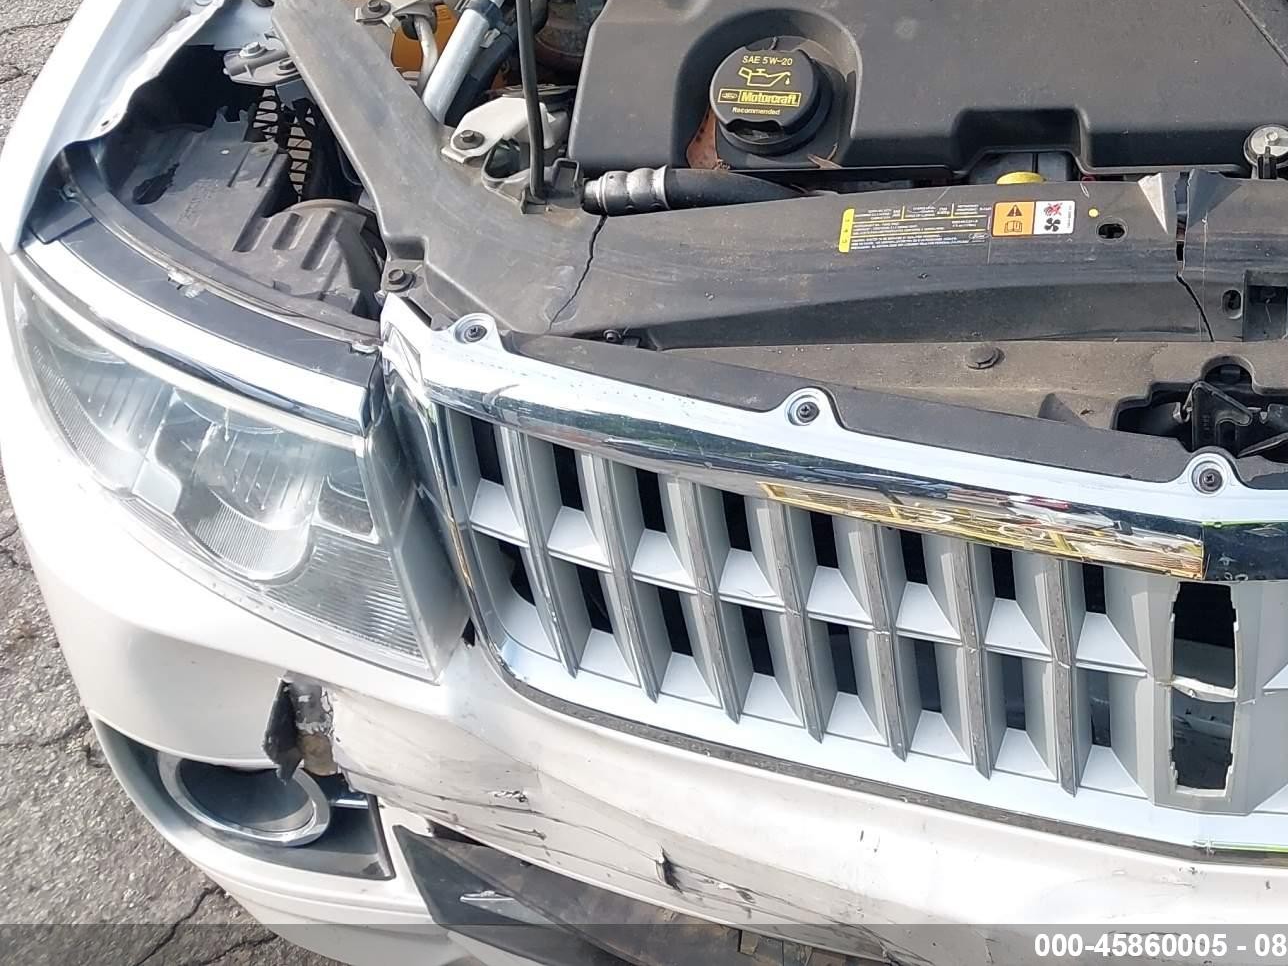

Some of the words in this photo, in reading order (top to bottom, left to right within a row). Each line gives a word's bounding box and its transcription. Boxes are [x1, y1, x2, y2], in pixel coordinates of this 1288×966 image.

[742, 55, 761, 65] SAE
[762, 56, 793, 66] 5W-20
[740, 91, 798, 105] Motorcraft
[732, 106, 781, 116] Recommended
